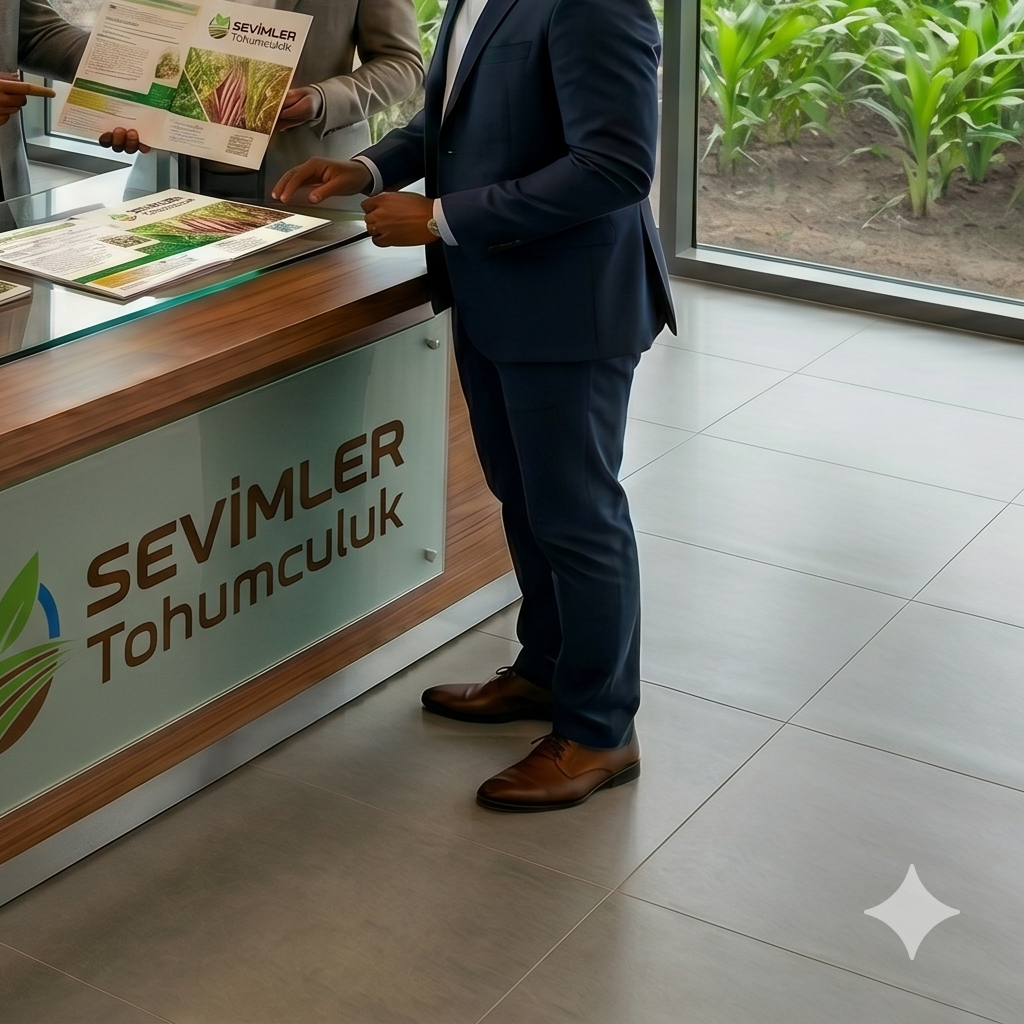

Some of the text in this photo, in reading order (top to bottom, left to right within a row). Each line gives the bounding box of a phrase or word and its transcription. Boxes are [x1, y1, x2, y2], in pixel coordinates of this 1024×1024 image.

[232, 21, 297, 42] SEVİMLER
[86, 419, 405, 619] SEVİMLER
[86, 486, 404, 684] Tohumculuk
